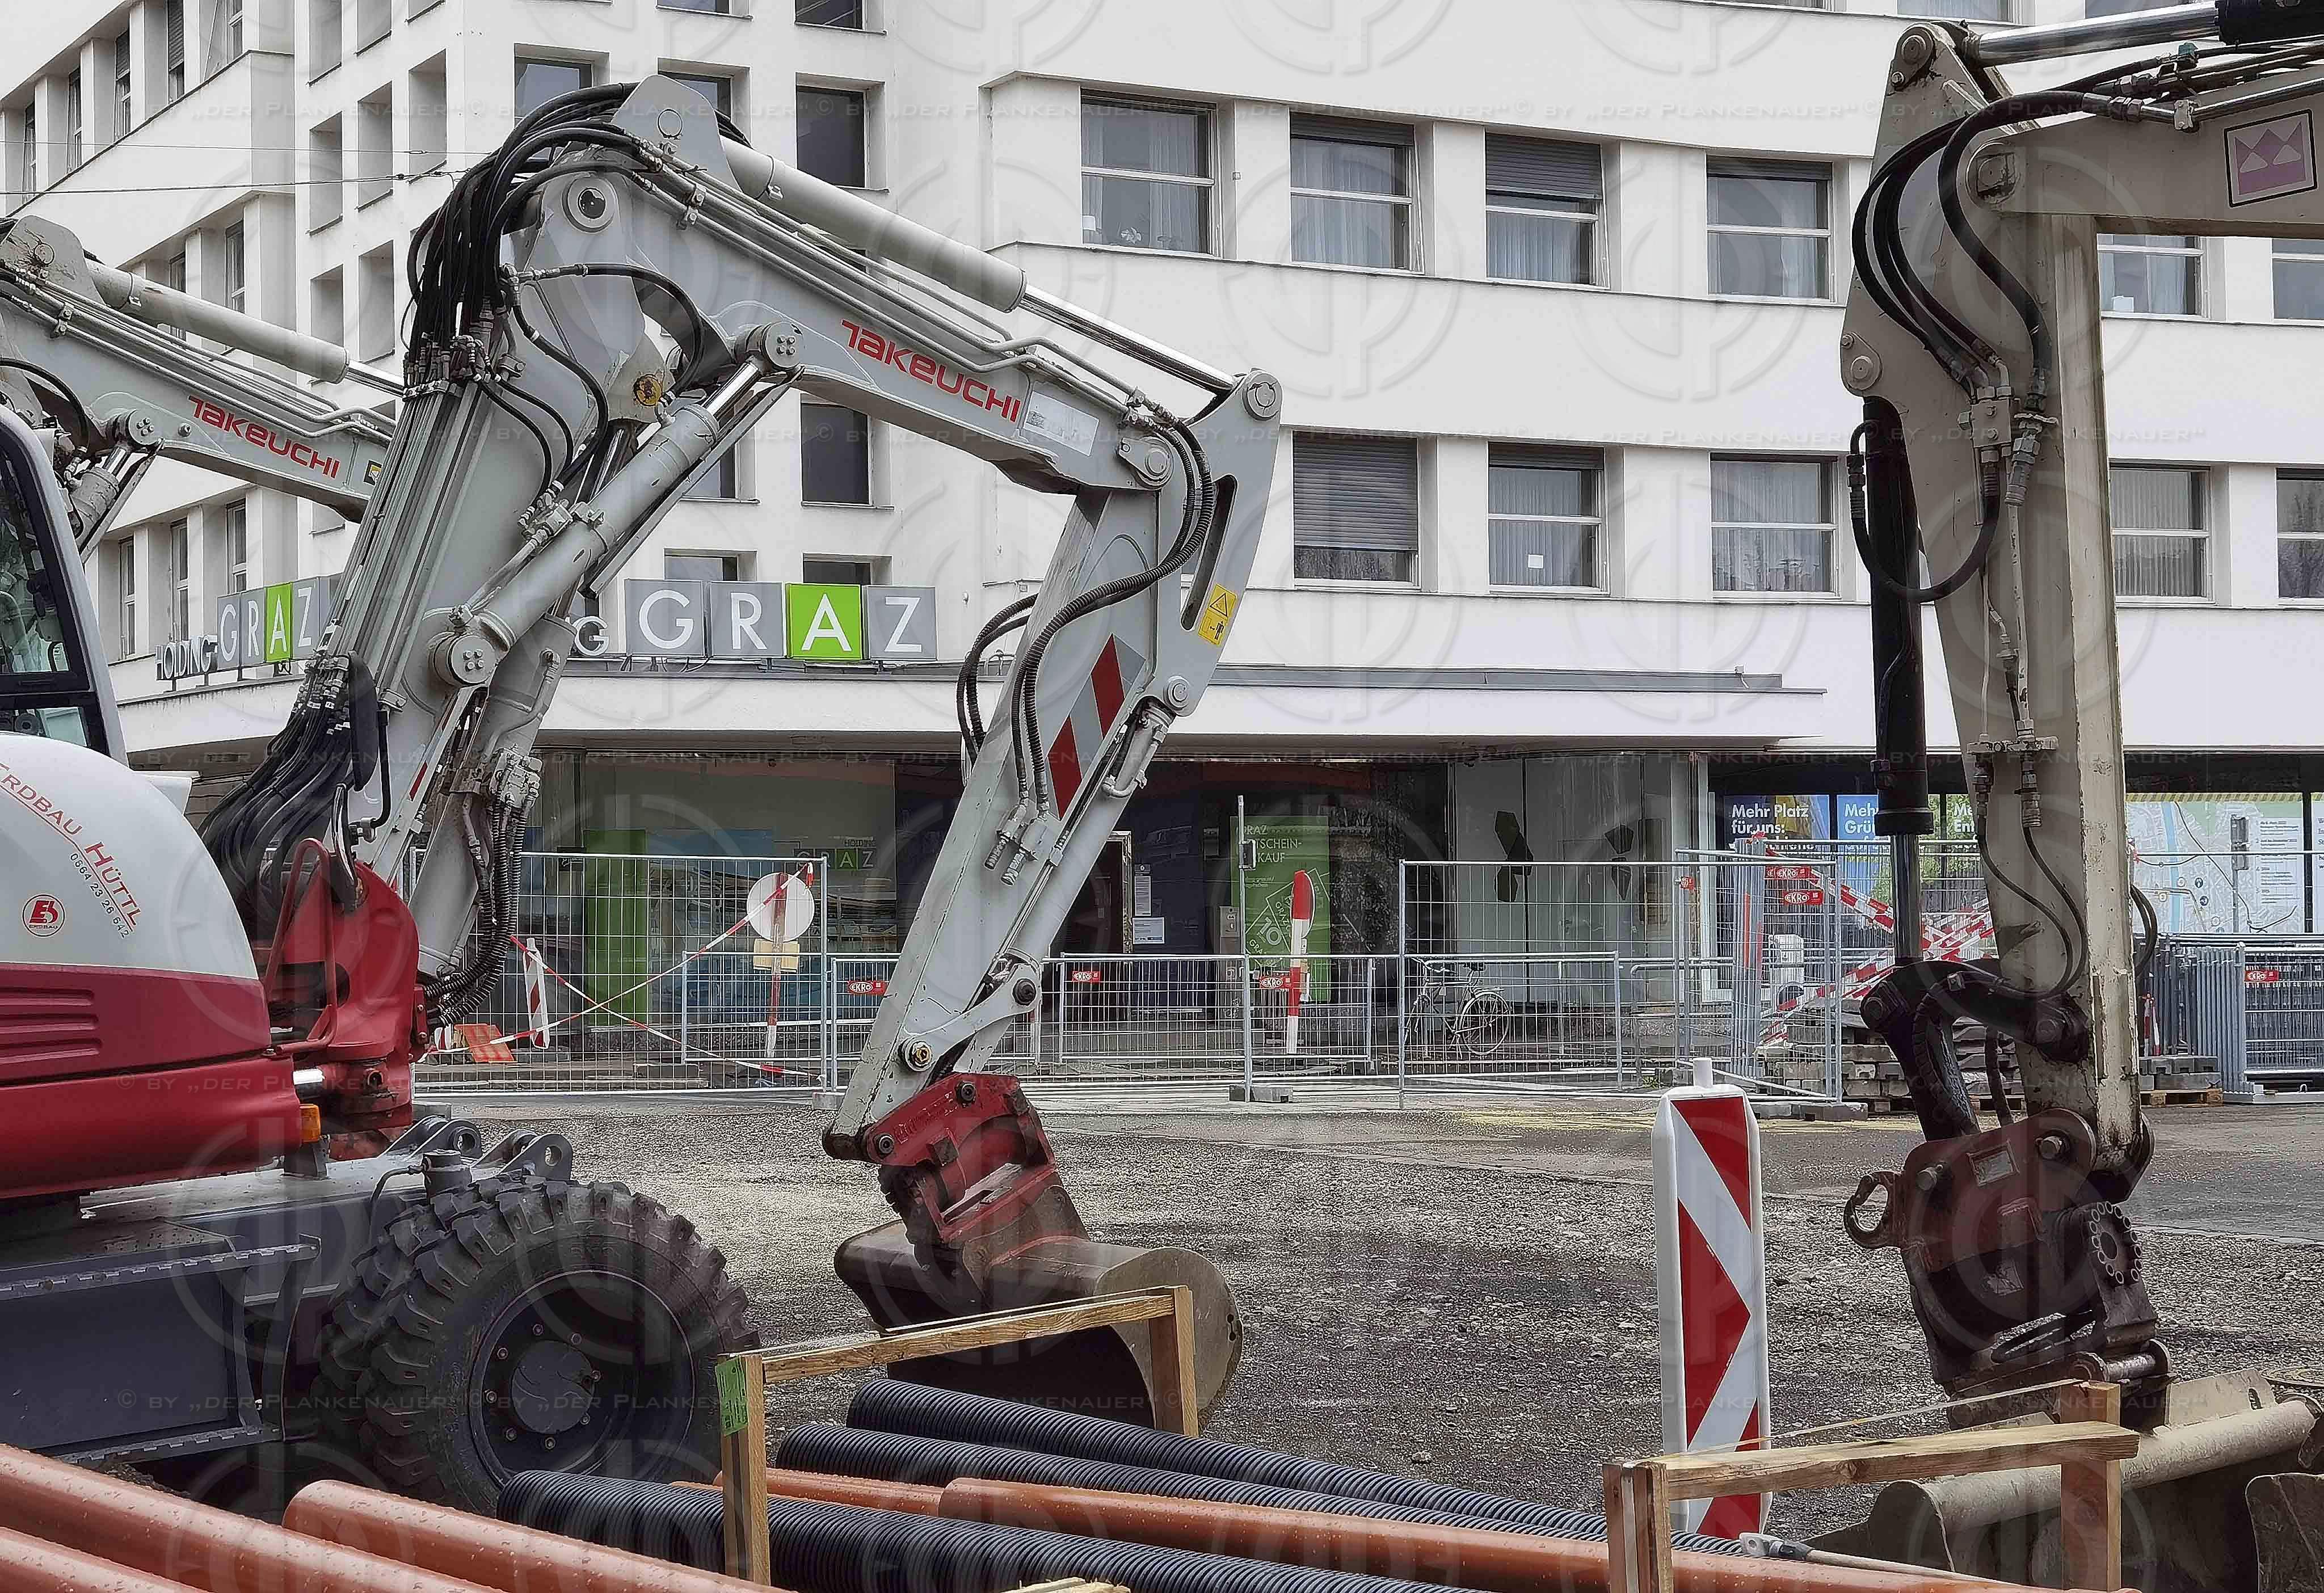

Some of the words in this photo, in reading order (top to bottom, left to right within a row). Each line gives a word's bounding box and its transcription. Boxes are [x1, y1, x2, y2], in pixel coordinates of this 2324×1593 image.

[220, 587, 312, 661] GRAZ
[639, 589, 923, 654] GRAZ
[1731, 803, 1770, 817] Mehr
[1774, 803, 1809, 817] Platz
[1731, 819, 1753, 834] für
[0, 762, 82, 835] RDBAU
[83, 841, 141, 926] HÜTTL
[90, 883, 104, 897] 23
[101, 900, 115, 914] 26
[1786, 893, 1808, 903] EKRO
[851, 983, 872, 992] EKRO
[1263, 978, 1281, 987] EKRO
